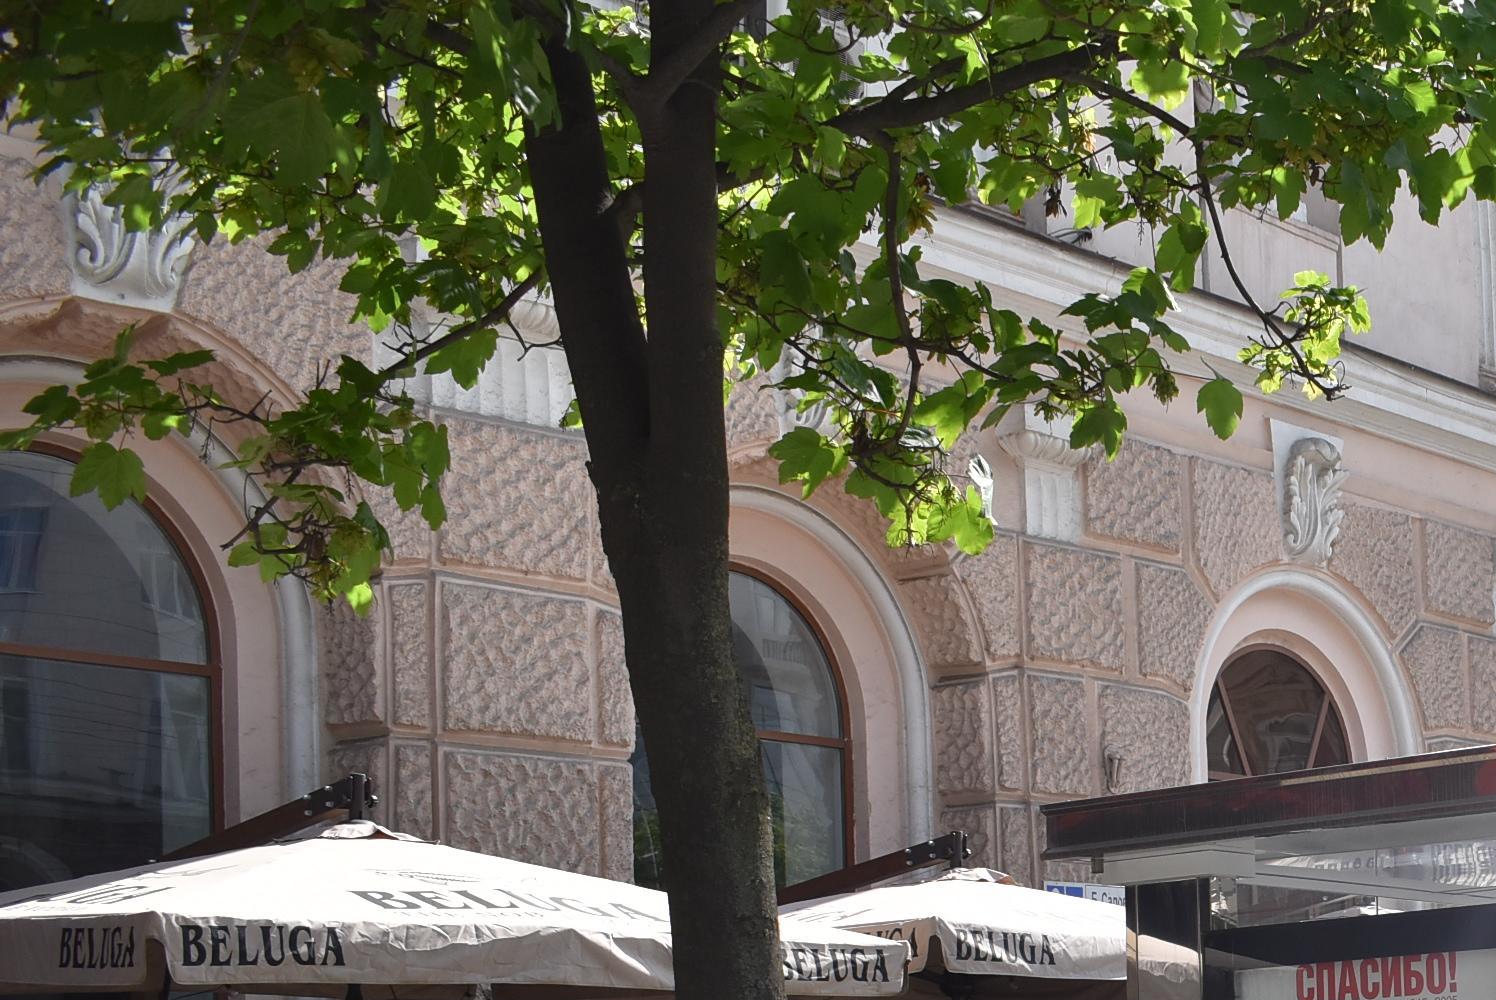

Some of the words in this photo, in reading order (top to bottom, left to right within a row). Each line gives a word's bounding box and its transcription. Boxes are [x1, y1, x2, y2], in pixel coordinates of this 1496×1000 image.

[59, 926, 135, 969] BELUGA
[180, 924, 346, 967] BELUGA
[956, 926, 1057, 966] BELUGA
